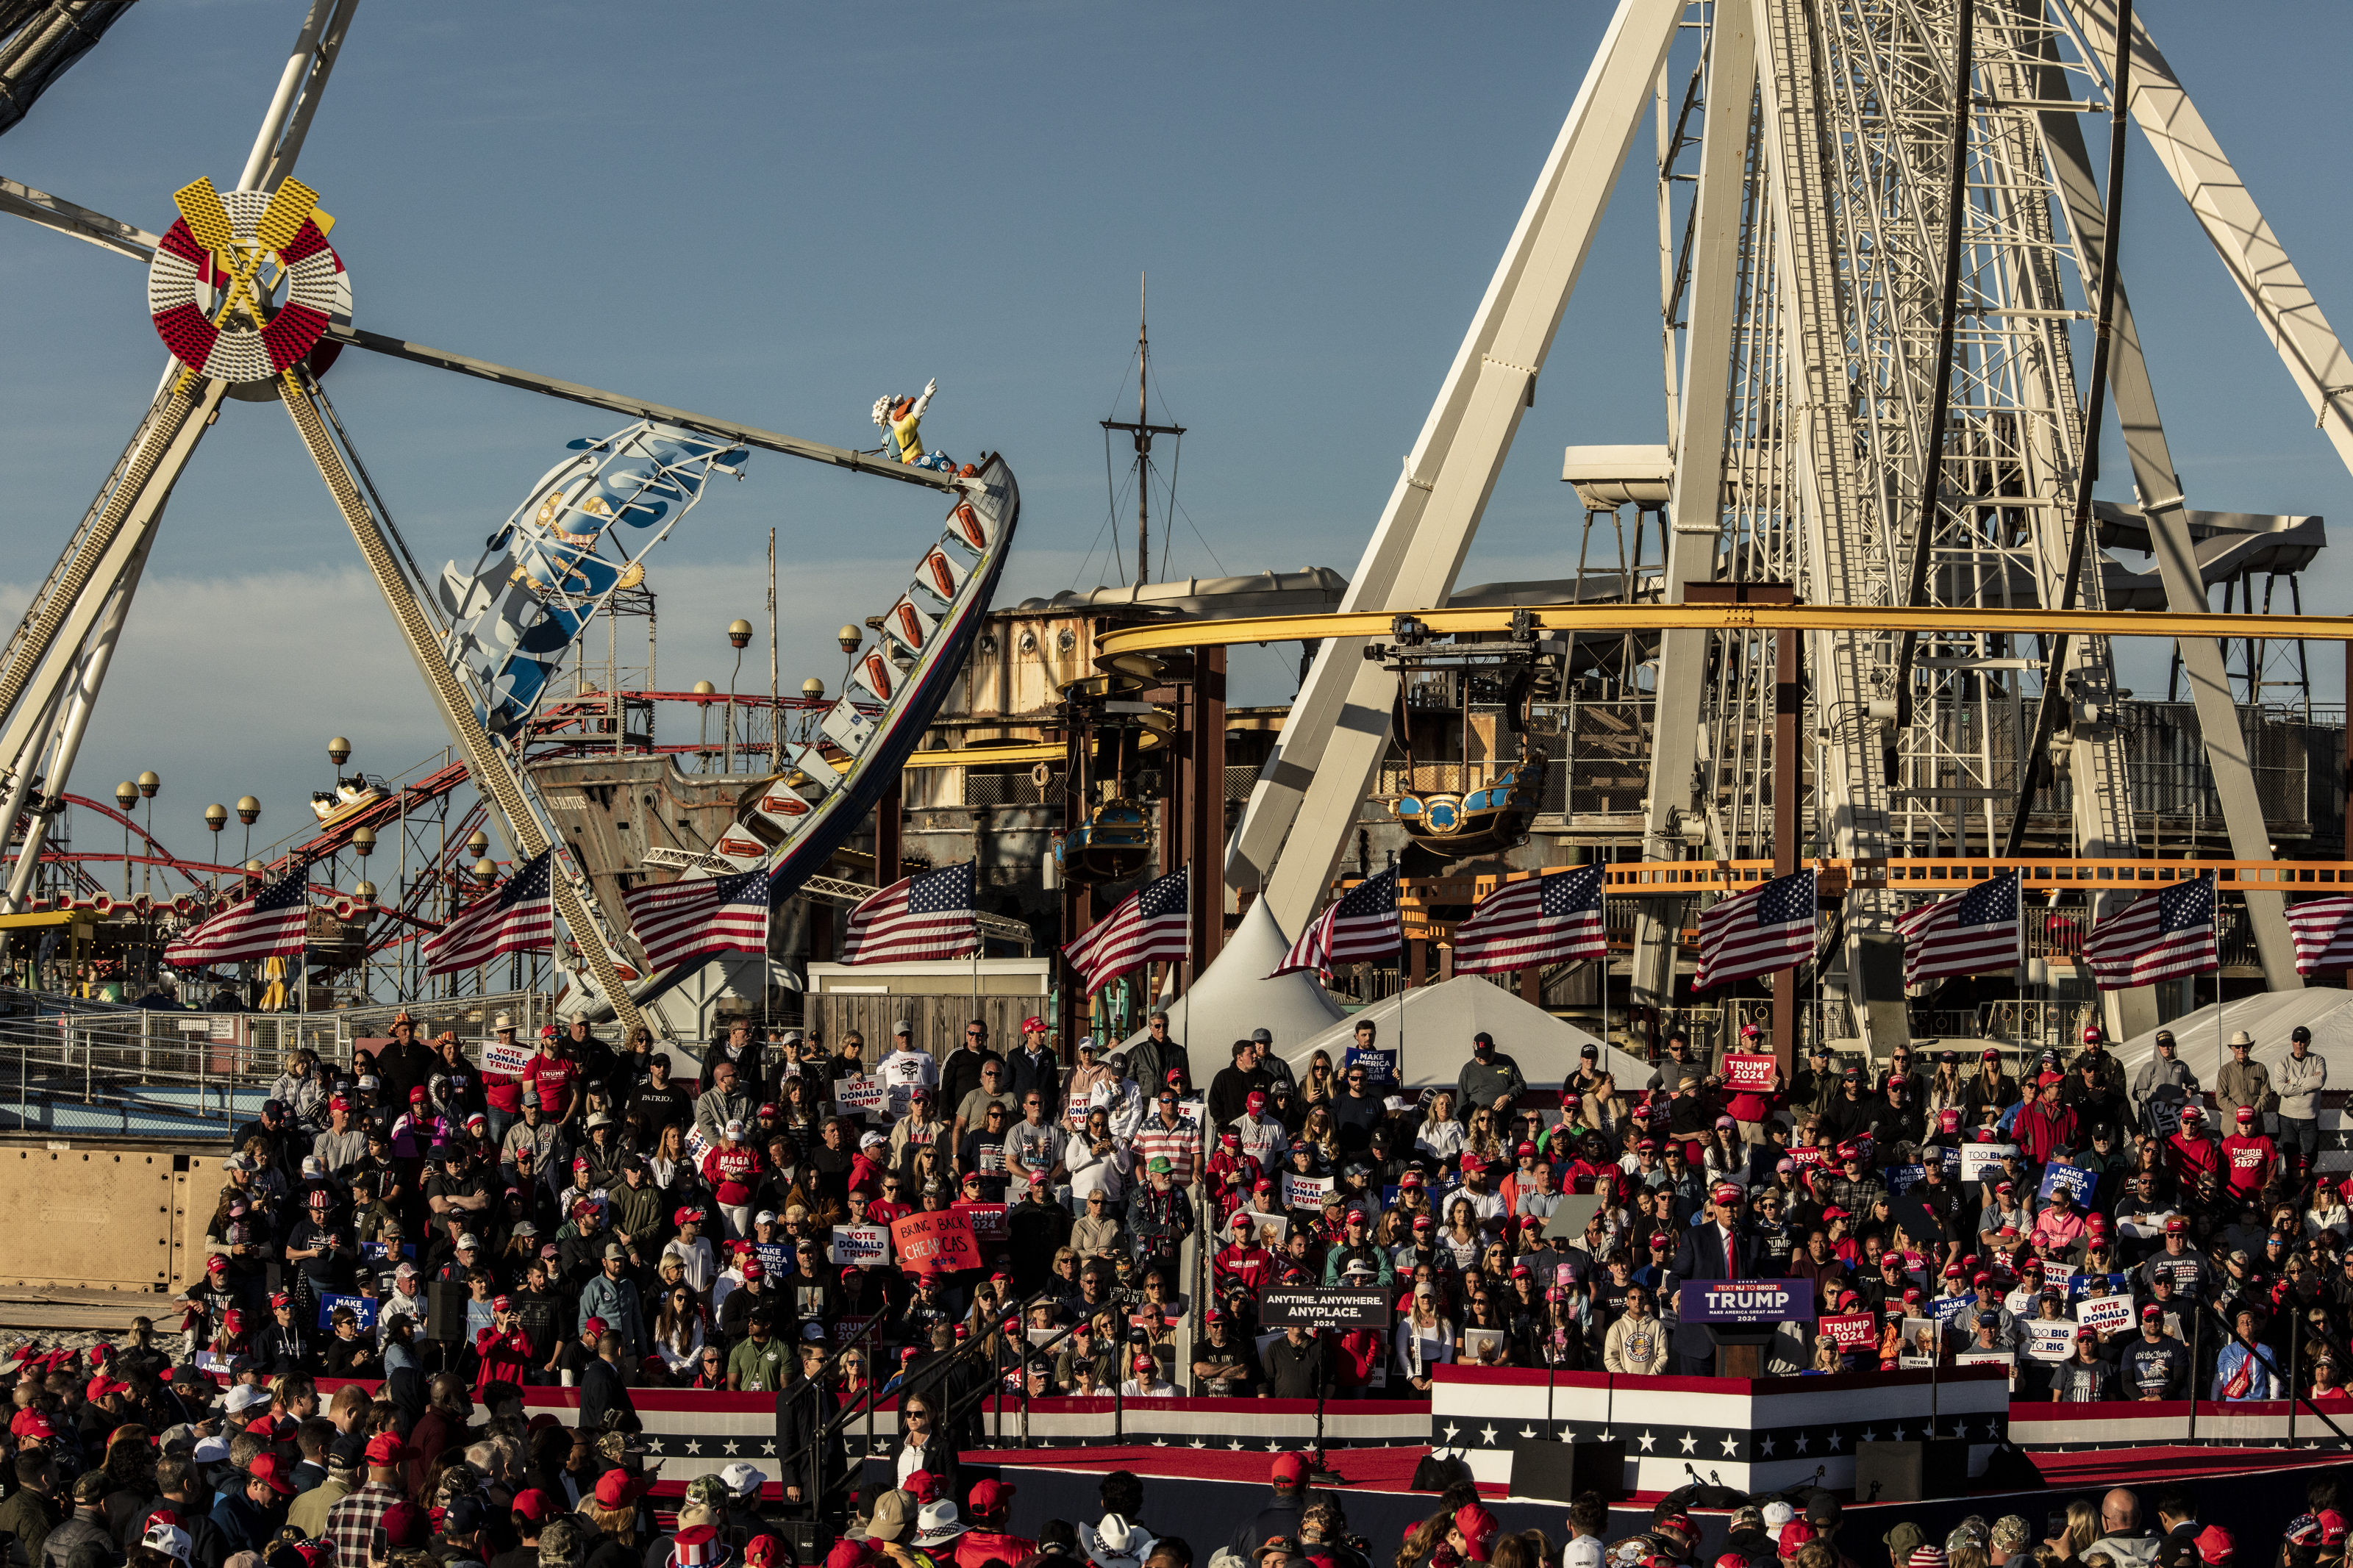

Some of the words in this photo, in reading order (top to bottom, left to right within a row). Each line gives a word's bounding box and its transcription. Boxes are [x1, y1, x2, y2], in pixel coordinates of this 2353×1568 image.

[496, 1047, 523, 1059] VOTE
[1360, 1053, 1385, 1061] MAKE
[486, 1052, 529, 1067] DONALD
[1352, 1059, 1390, 1067] AMERICA
[1728, 1061, 1771, 1070] TRUMP
[1734, 1070, 1764, 1080] 2024
[847, 1081, 875, 1091] VOTE
[840, 1088, 883, 1100] DONALD
[893, 1091, 911, 1100] TOO
[844, 1097, 881, 1108] TRUMP
[895, 1103, 907, 1112] TO
[2232, 1148, 2262, 1157] Trump
[721, 1156, 749, 1165] MAGA
[1790, 1153, 1821, 1163] TRUM
[2235, 1159, 2259, 1167] 2024
[1900, 1168, 1924, 1176] MAKE
[2058, 1167, 2084, 1178] MAKE
[1893, 1175, 1927, 1184] AMERIC
[2049, 1173, 2088, 1189] AMERICA
[1293, 1181, 1321, 1190] VOTE
[1285, 1187, 1324, 1198] DONAL
[1288, 1195, 1322, 1205] TRUM
[901, 1220, 931, 1239] BRING
[938, 1216, 967, 1231] BACK
[847, 1231, 876, 1240] VOTE
[838, 1239, 884, 1249] DONALD
[904, 1238, 940, 1260] CHEAP
[756, 1247, 781, 1256] MAKE
[842, 1249, 881, 1258] TRUMP
[335, 1298, 363, 1306] MAKE
[1267, 1295, 1317, 1304] ANYTIME.
[1319, 1296, 1383, 1305] ANYWHERE.
[1705, 1292, 1789, 1309] TRUMP
[1940, 1300, 1967, 1310] MAKE
[2015, 1300, 2035, 1309] TOO
[1288, 1306, 1362, 1317] ANYPLACE.
[2090, 1302, 2119, 1312] VOTE
[2083, 1309, 2129, 1323] DONALD
[1825, 1320, 1870, 1332] TRUMP
[1835, 1331, 1865, 1342] 2024
[2028, 1328, 2049, 1337] TOO
[2052, 1329, 2069, 1337] BIG
[2031, 1341, 2043, 1350] TO
[2046, 1342, 2064, 1351] RIG
[176, 1545, 188, 1556] 45
